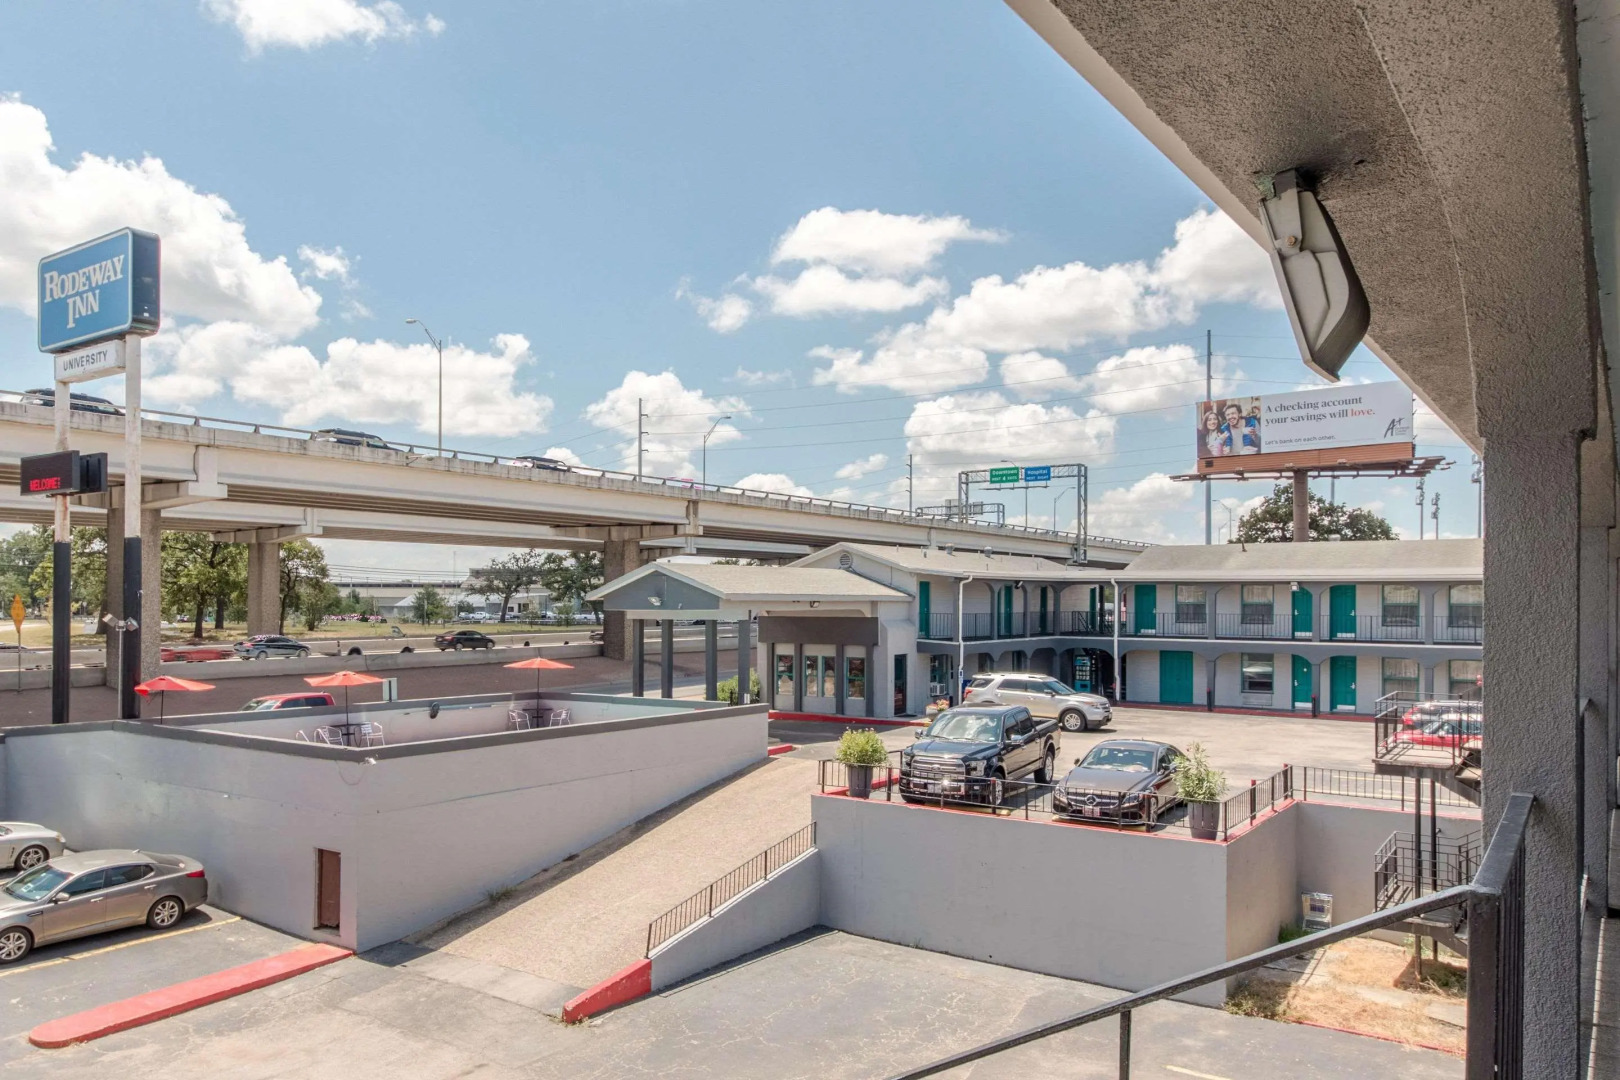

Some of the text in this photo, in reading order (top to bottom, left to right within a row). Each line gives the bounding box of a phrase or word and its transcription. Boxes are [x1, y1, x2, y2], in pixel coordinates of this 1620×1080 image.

[44, 255, 125, 303] RODEWAY
[67, 290, 100, 329] INN
[63, 350, 108, 371] UNIVERSITY
[1266, 396, 1363, 413] A checking account
[1265, 407, 1375, 427] your savings will love.
[1279, 436, 1293, 444] bank
[1303, 434, 1317, 442] each
